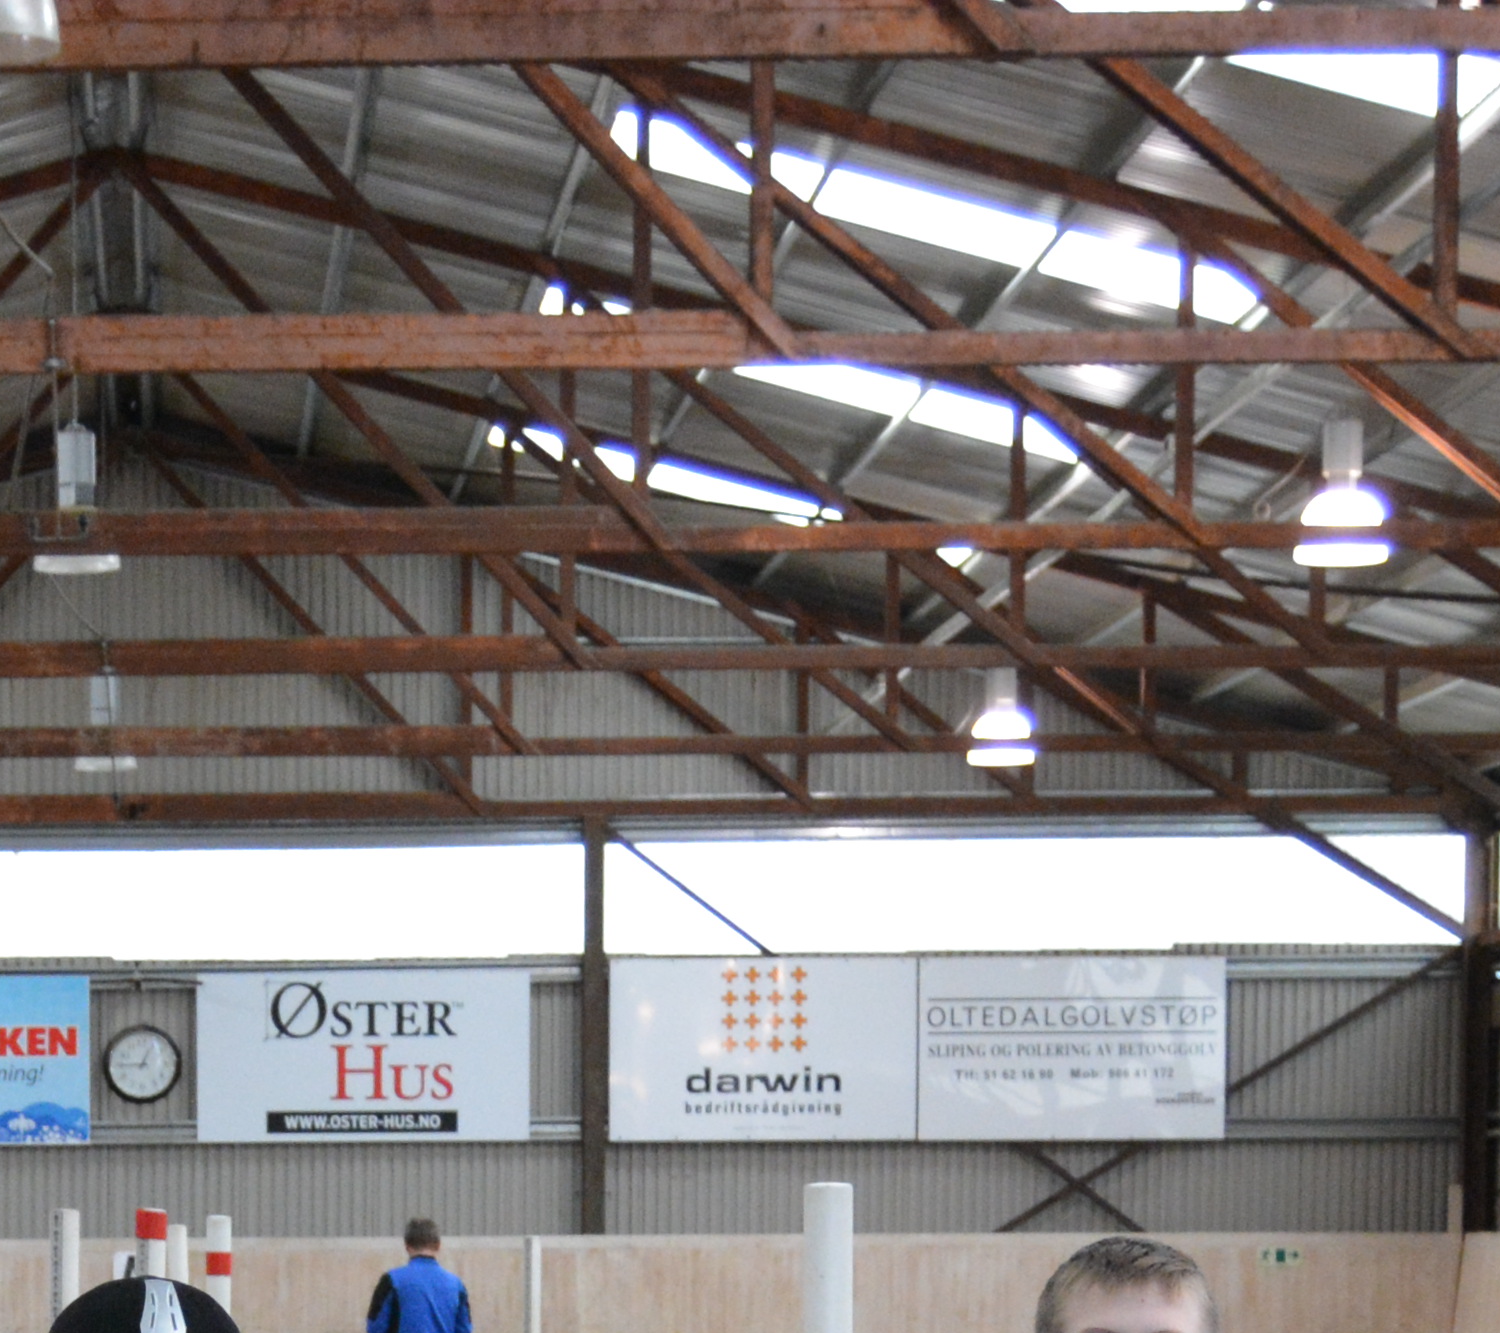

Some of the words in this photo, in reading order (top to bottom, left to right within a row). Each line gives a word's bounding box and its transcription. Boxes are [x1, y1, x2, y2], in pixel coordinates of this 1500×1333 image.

[270, 981, 457, 1038] ØSTER
[927, 1004, 1217, 1028] OLTEDALGOLVSTØP
[927, 1043, 986, 1059] SLIPING
[991, 1043, 1012, 1058] OG
[1017, 1043, 1095, 1058] POLERING
[1097, 1043, 1112, 1058] AV
[685, 1065, 842, 1094] darwin
[685, 1101, 843, 1116] bedriftsrådgivning
[284, 1114, 441, 1130] WWW.OSTER-HUS.NO
